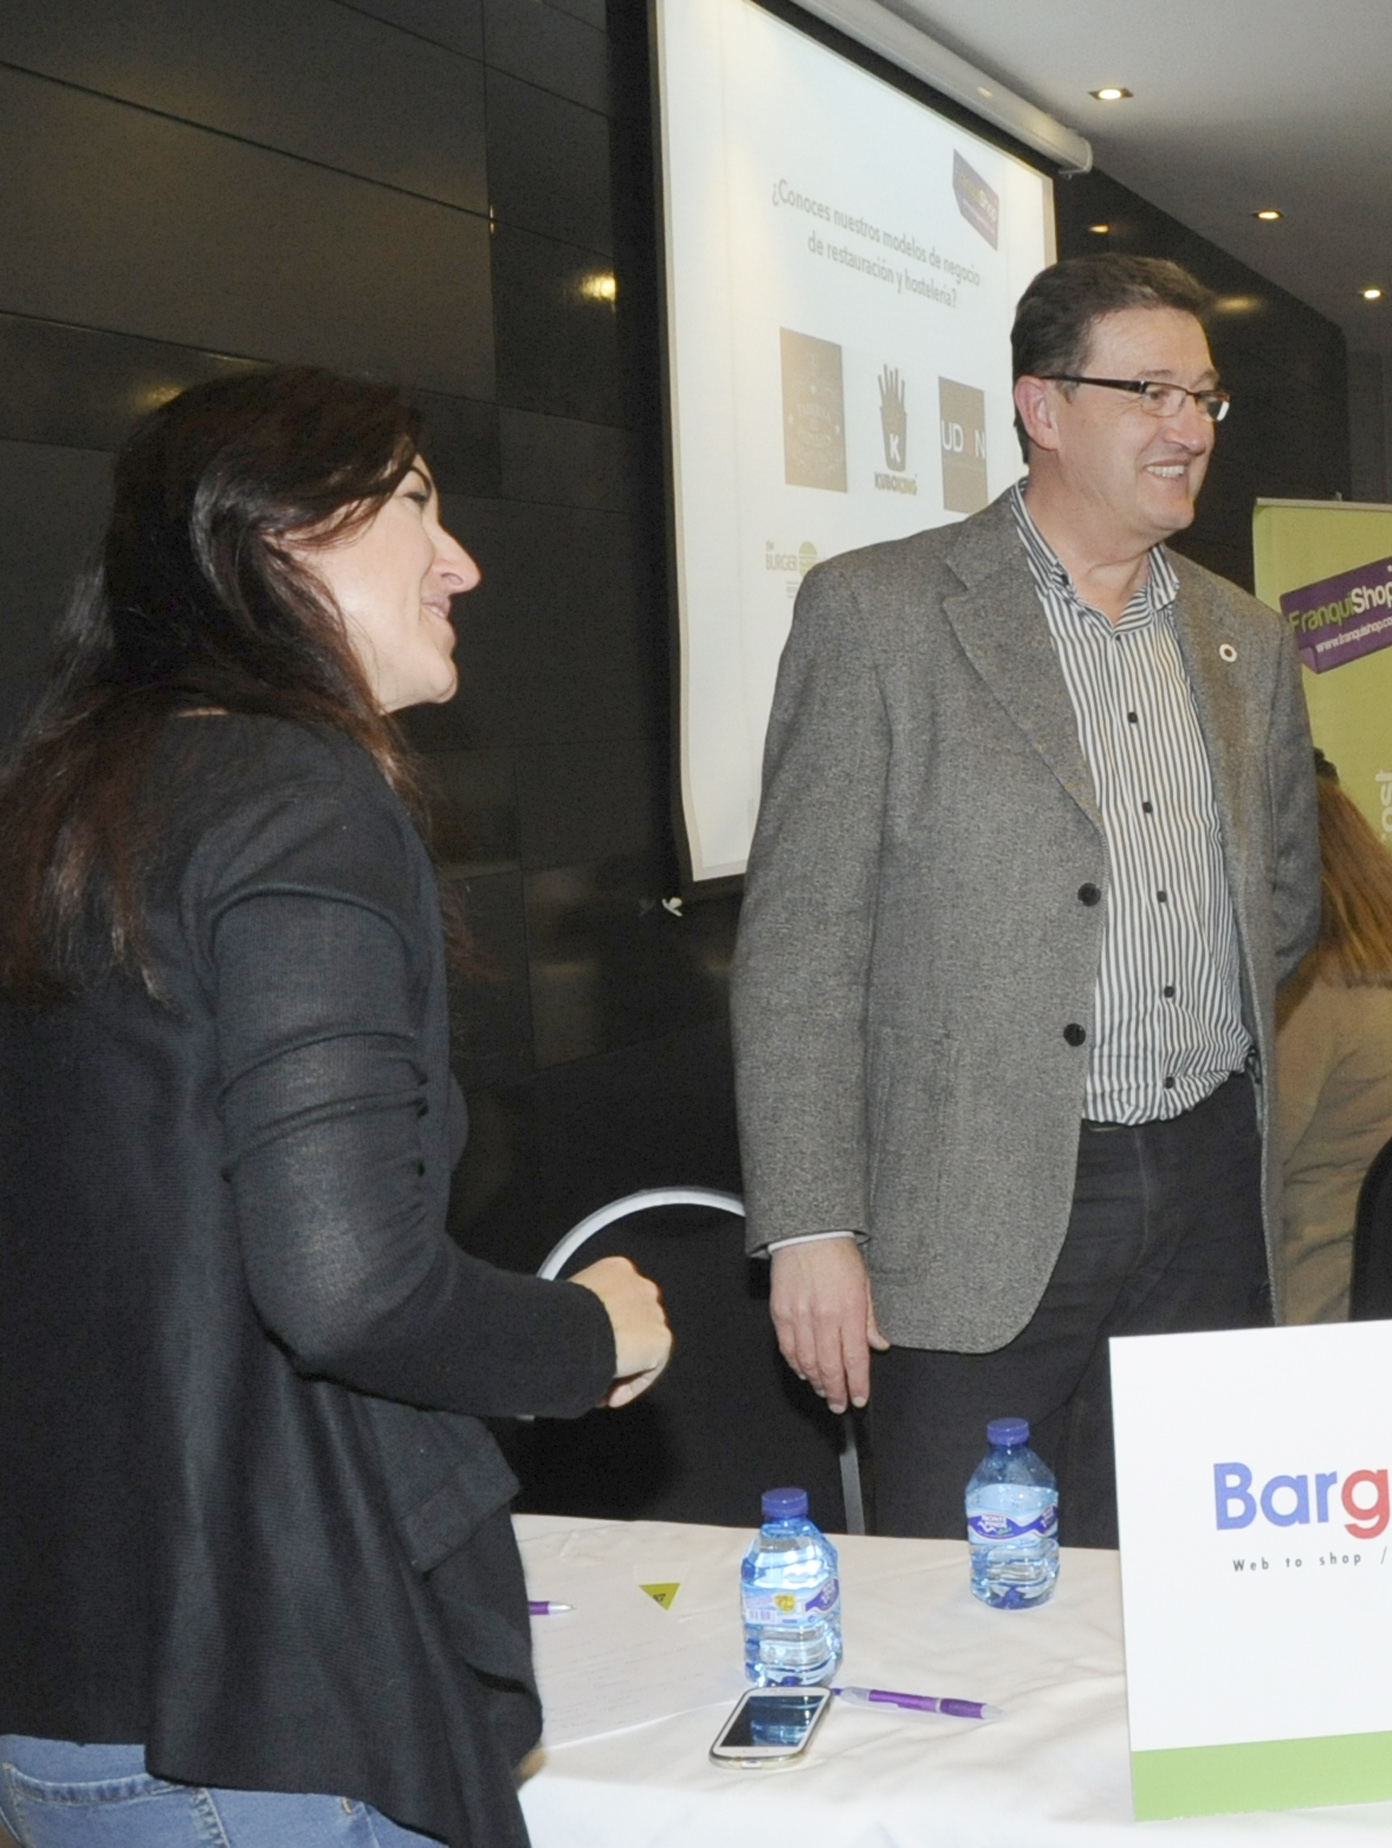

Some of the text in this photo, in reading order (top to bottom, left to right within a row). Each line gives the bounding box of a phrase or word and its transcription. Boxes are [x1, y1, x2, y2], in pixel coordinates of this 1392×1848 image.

[771, 178, 981, 286] ¿Conoces nuestros modelos de negocio
[808, 230, 824, 256] de
[827, 244, 894, 284] restauración
[896, 271, 903, 293] y
[1232, 1557, 1269, 1572] Web
[1285, 1557, 1303, 1569] to
[1319, 1552, 1361, 1566] shop
